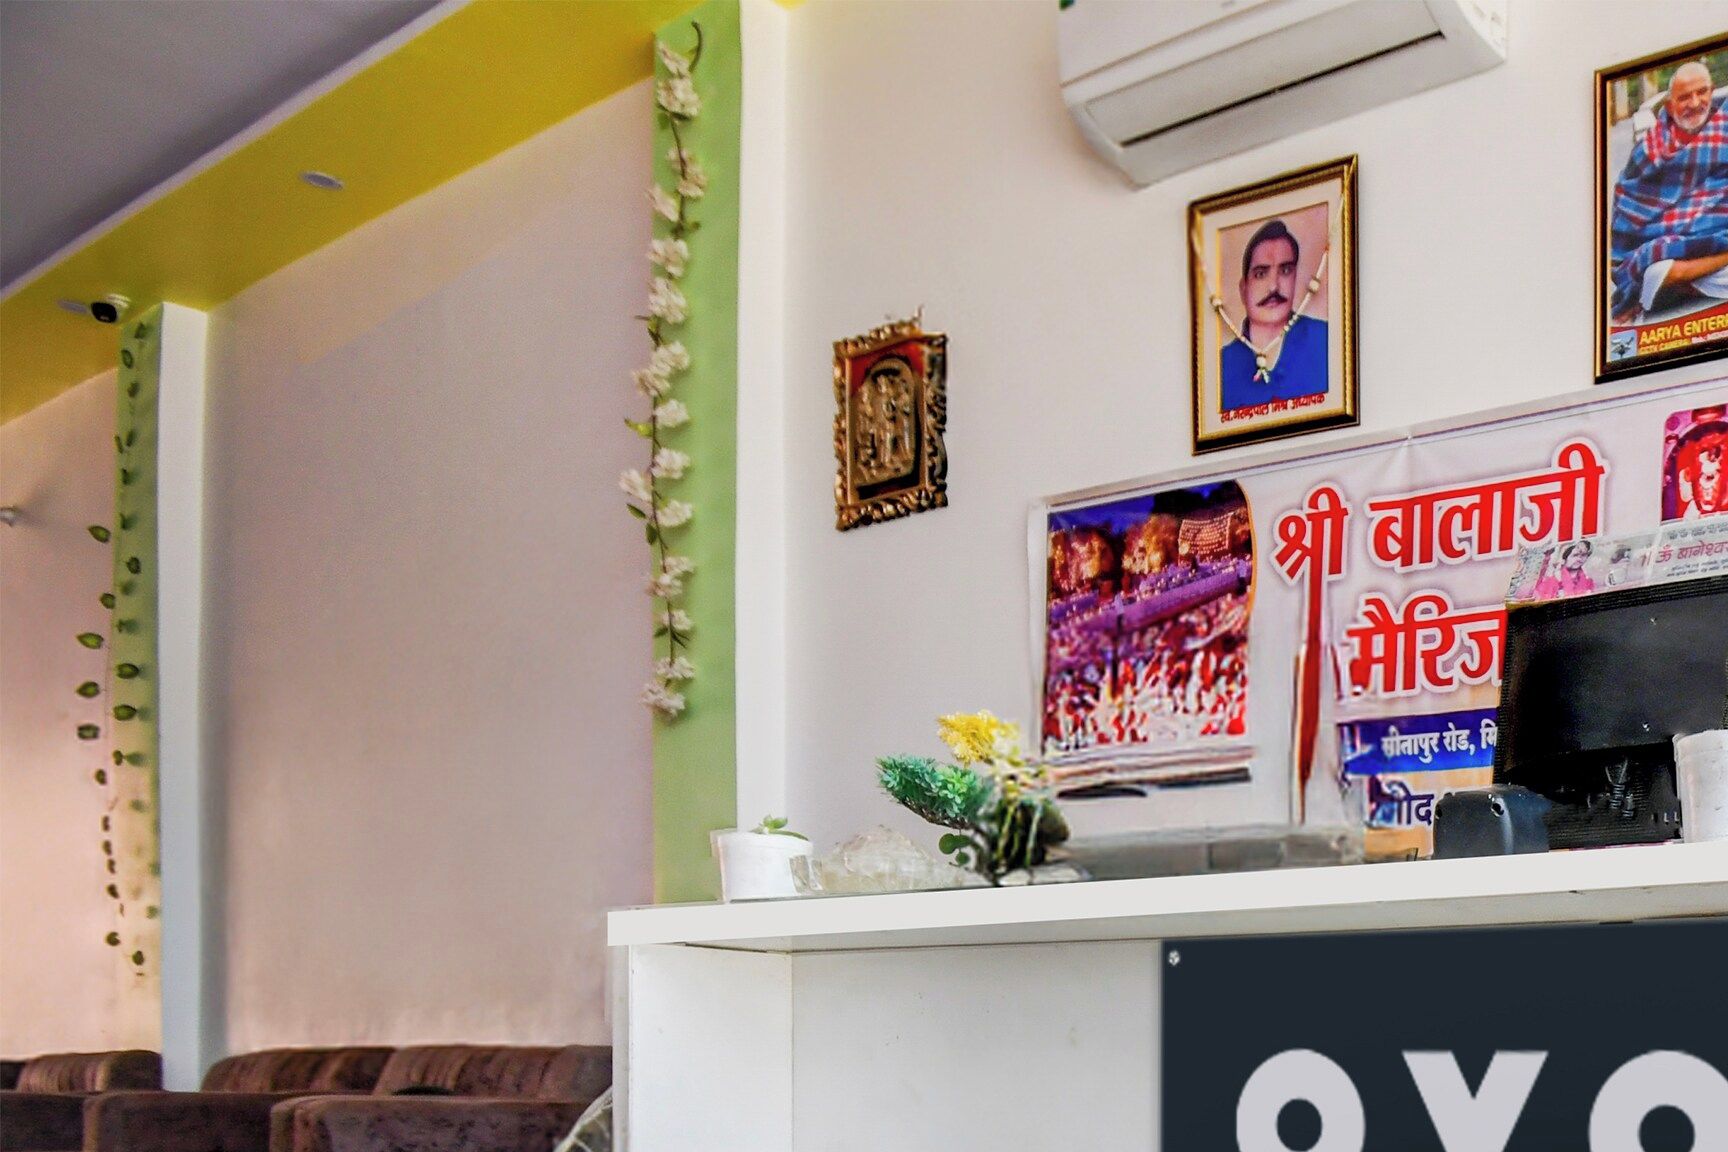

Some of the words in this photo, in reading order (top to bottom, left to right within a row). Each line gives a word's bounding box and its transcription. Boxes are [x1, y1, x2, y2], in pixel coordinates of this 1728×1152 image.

[1639, 324, 1682, 345] AARYA
[1275, 487, 1349, 580] श्री
[1369, 442, 1605, 568] बालाजी
[1347, 595, 1507, 693] मैरिज
[1381, 725, 1440, 763] सीतापुर
[1443, 722, 1475, 756] रोड,
